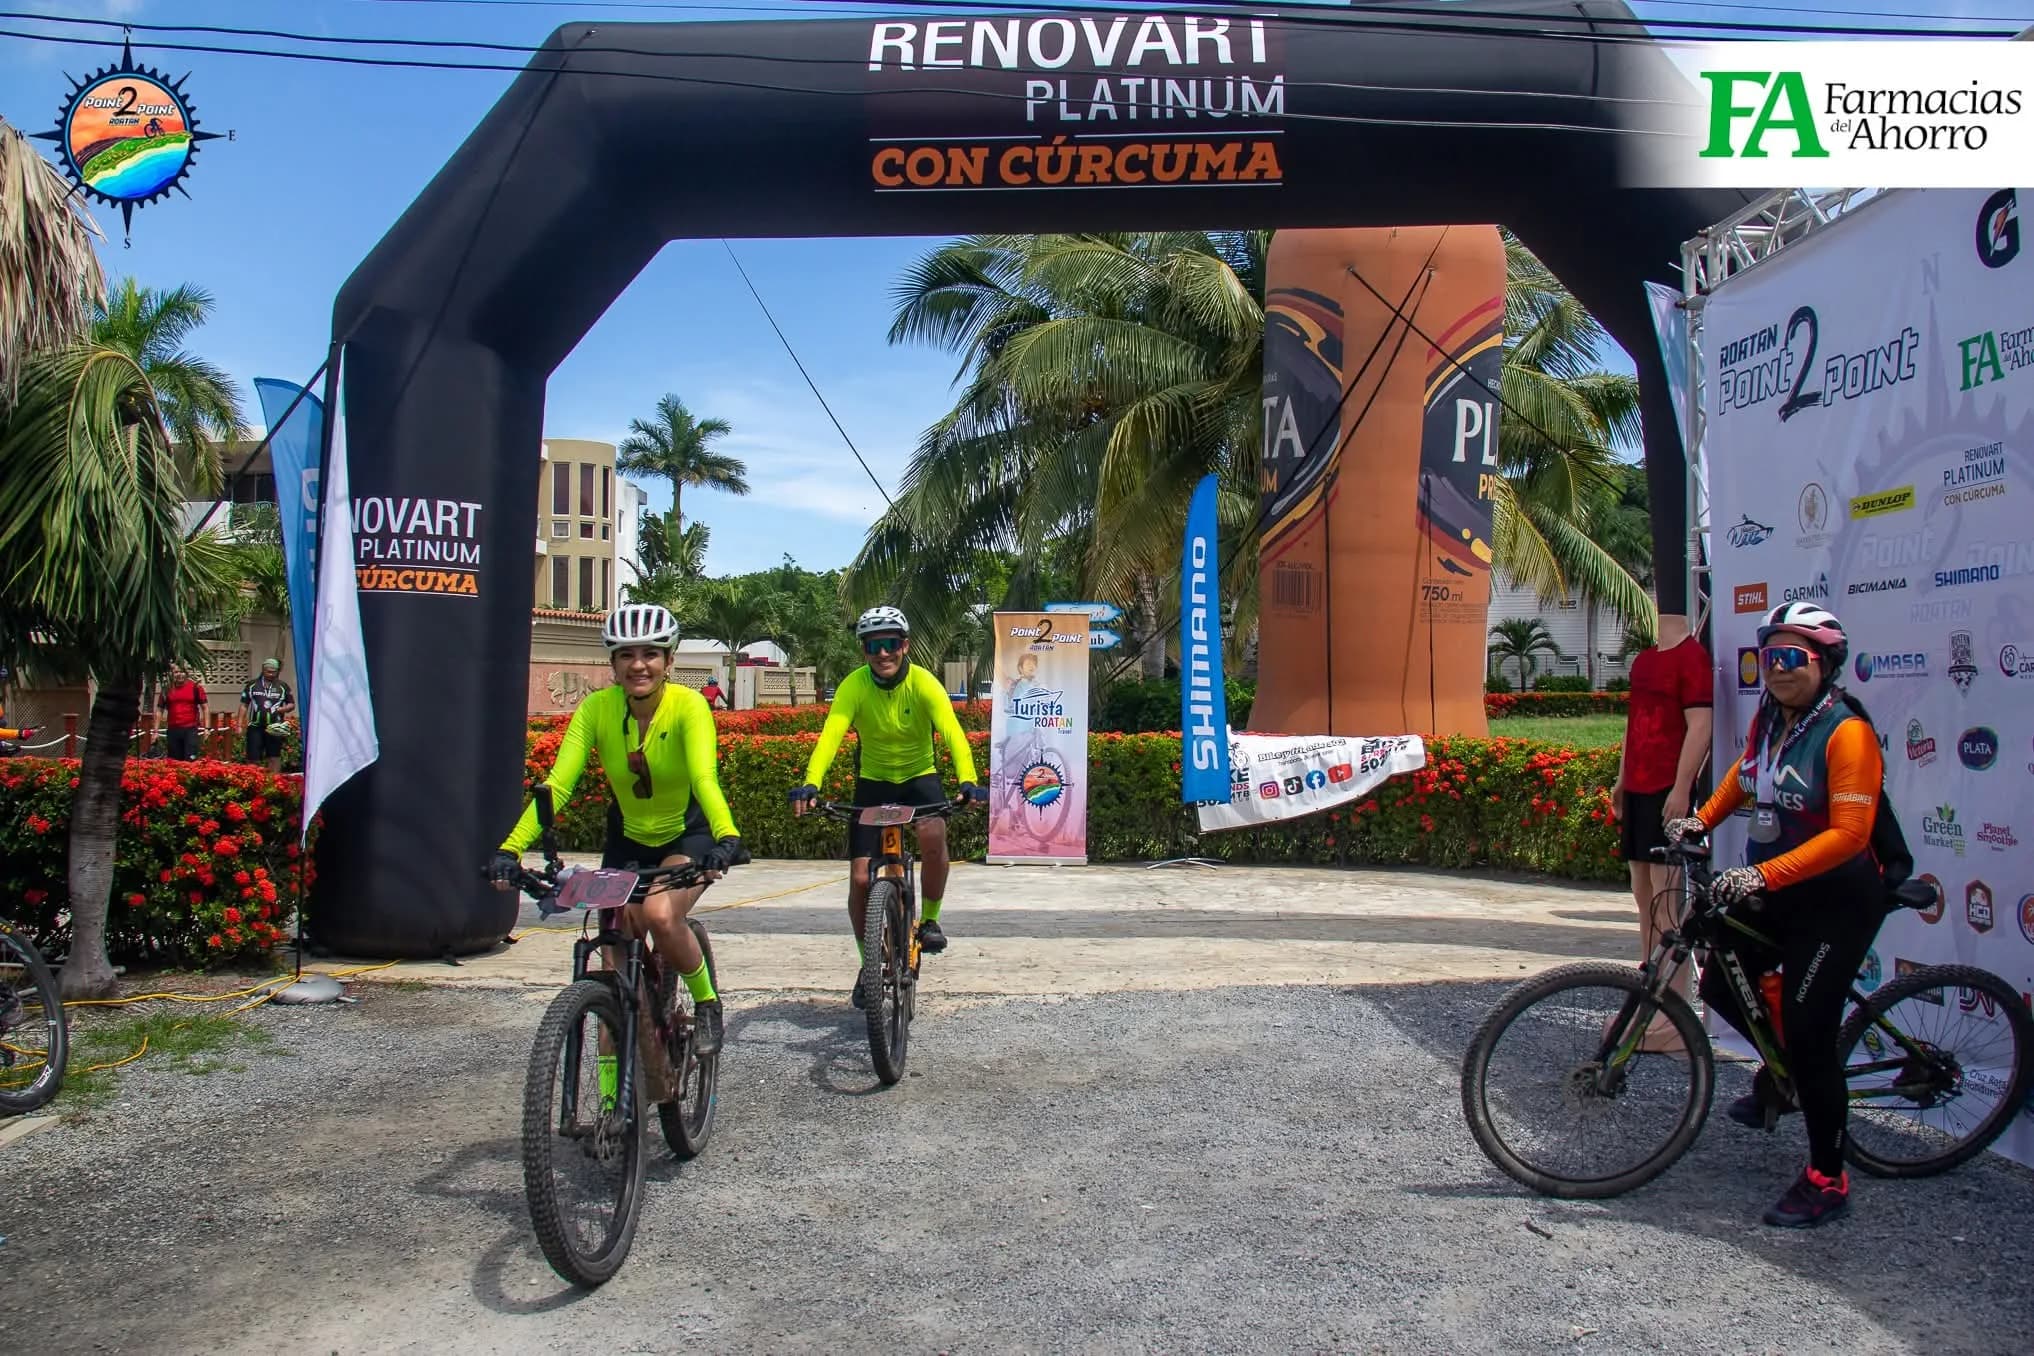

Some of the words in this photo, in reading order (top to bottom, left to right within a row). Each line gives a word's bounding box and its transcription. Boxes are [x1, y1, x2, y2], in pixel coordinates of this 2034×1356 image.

[869, 14, 1279, 71] RENOVART
[1026, 75, 1284, 121] PLATINUM
[872, 147, 989, 186] CON
[1000, 136, 1282, 184] CÚRCUMA
[1720, 324, 1778, 369] ROATAN
[1778, 305, 1822, 423] 2
[1957, 331, 2005, 392] FA
[1452, 398, 1497, 467] PL
[1964, 441, 2004, 462] RENOVART
[1944, 457, 2005, 487] PLATINUM
[1861, 491, 1911, 511] DUNLOP
[1944, 493, 1961, 506] CON
[360, 538, 480, 564] PLATINUM
[1848, 577, 1908, 595] BICIMANIA
[1935, 564, 2000, 587] SHIMANO
[1422, 585, 1449, 601] 750
[1452, 591, 1463, 601] ml
[1737, 591, 1764, 605] STIHL
[1783, 584, 1829, 602] GARMIN
[1033, 619, 1053, 644] 2
[1191, 536, 1220, 771] SHIMANO
[1872, 653, 1926, 673] IMASA
[1013, 698, 1063, 716] Turista
[1034, 716, 1073, 728] ROATAN
[1963, 741, 1992, 755] PLATA
[1922, 816, 1963, 837] Green
[1923, 834, 1953, 849] Market
[569, 879, 629, 899] 103
[1796, 941, 1832, 1004] ROCKBROS
[1725, 949, 1765, 1023] TREK
